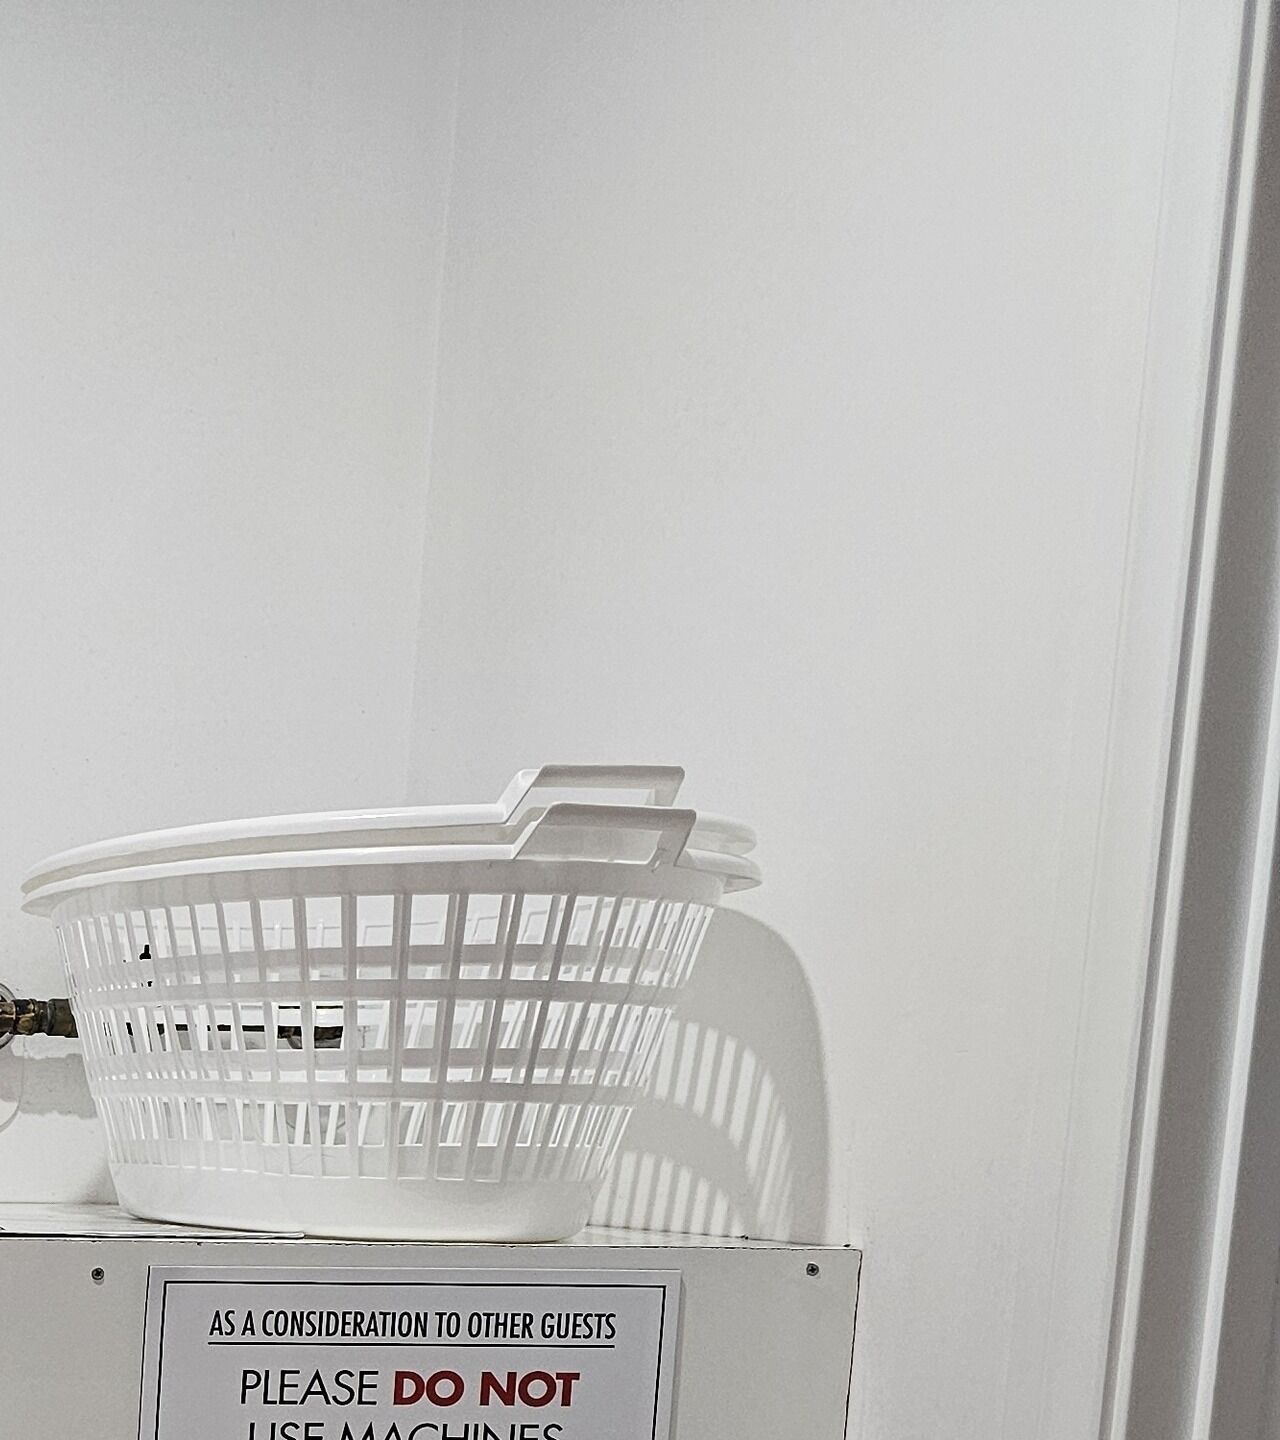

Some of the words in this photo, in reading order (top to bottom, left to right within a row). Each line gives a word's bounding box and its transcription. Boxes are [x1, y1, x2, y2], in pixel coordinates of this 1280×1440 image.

[209, 1310, 236, 1337] AS
[241, 1311, 255, 1337] A
[262, 1310, 427, 1339] CONSIDERATION
[435, 1312, 461, 1338] TO
[467, 1312, 534, 1339] OTHER
[540, 1313, 616, 1341] GUESTS
[240, 1369, 379, 1406] PLEASE
[392, 1370, 465, 1408] DO
[479, 1371, 580, 1408] NOT
